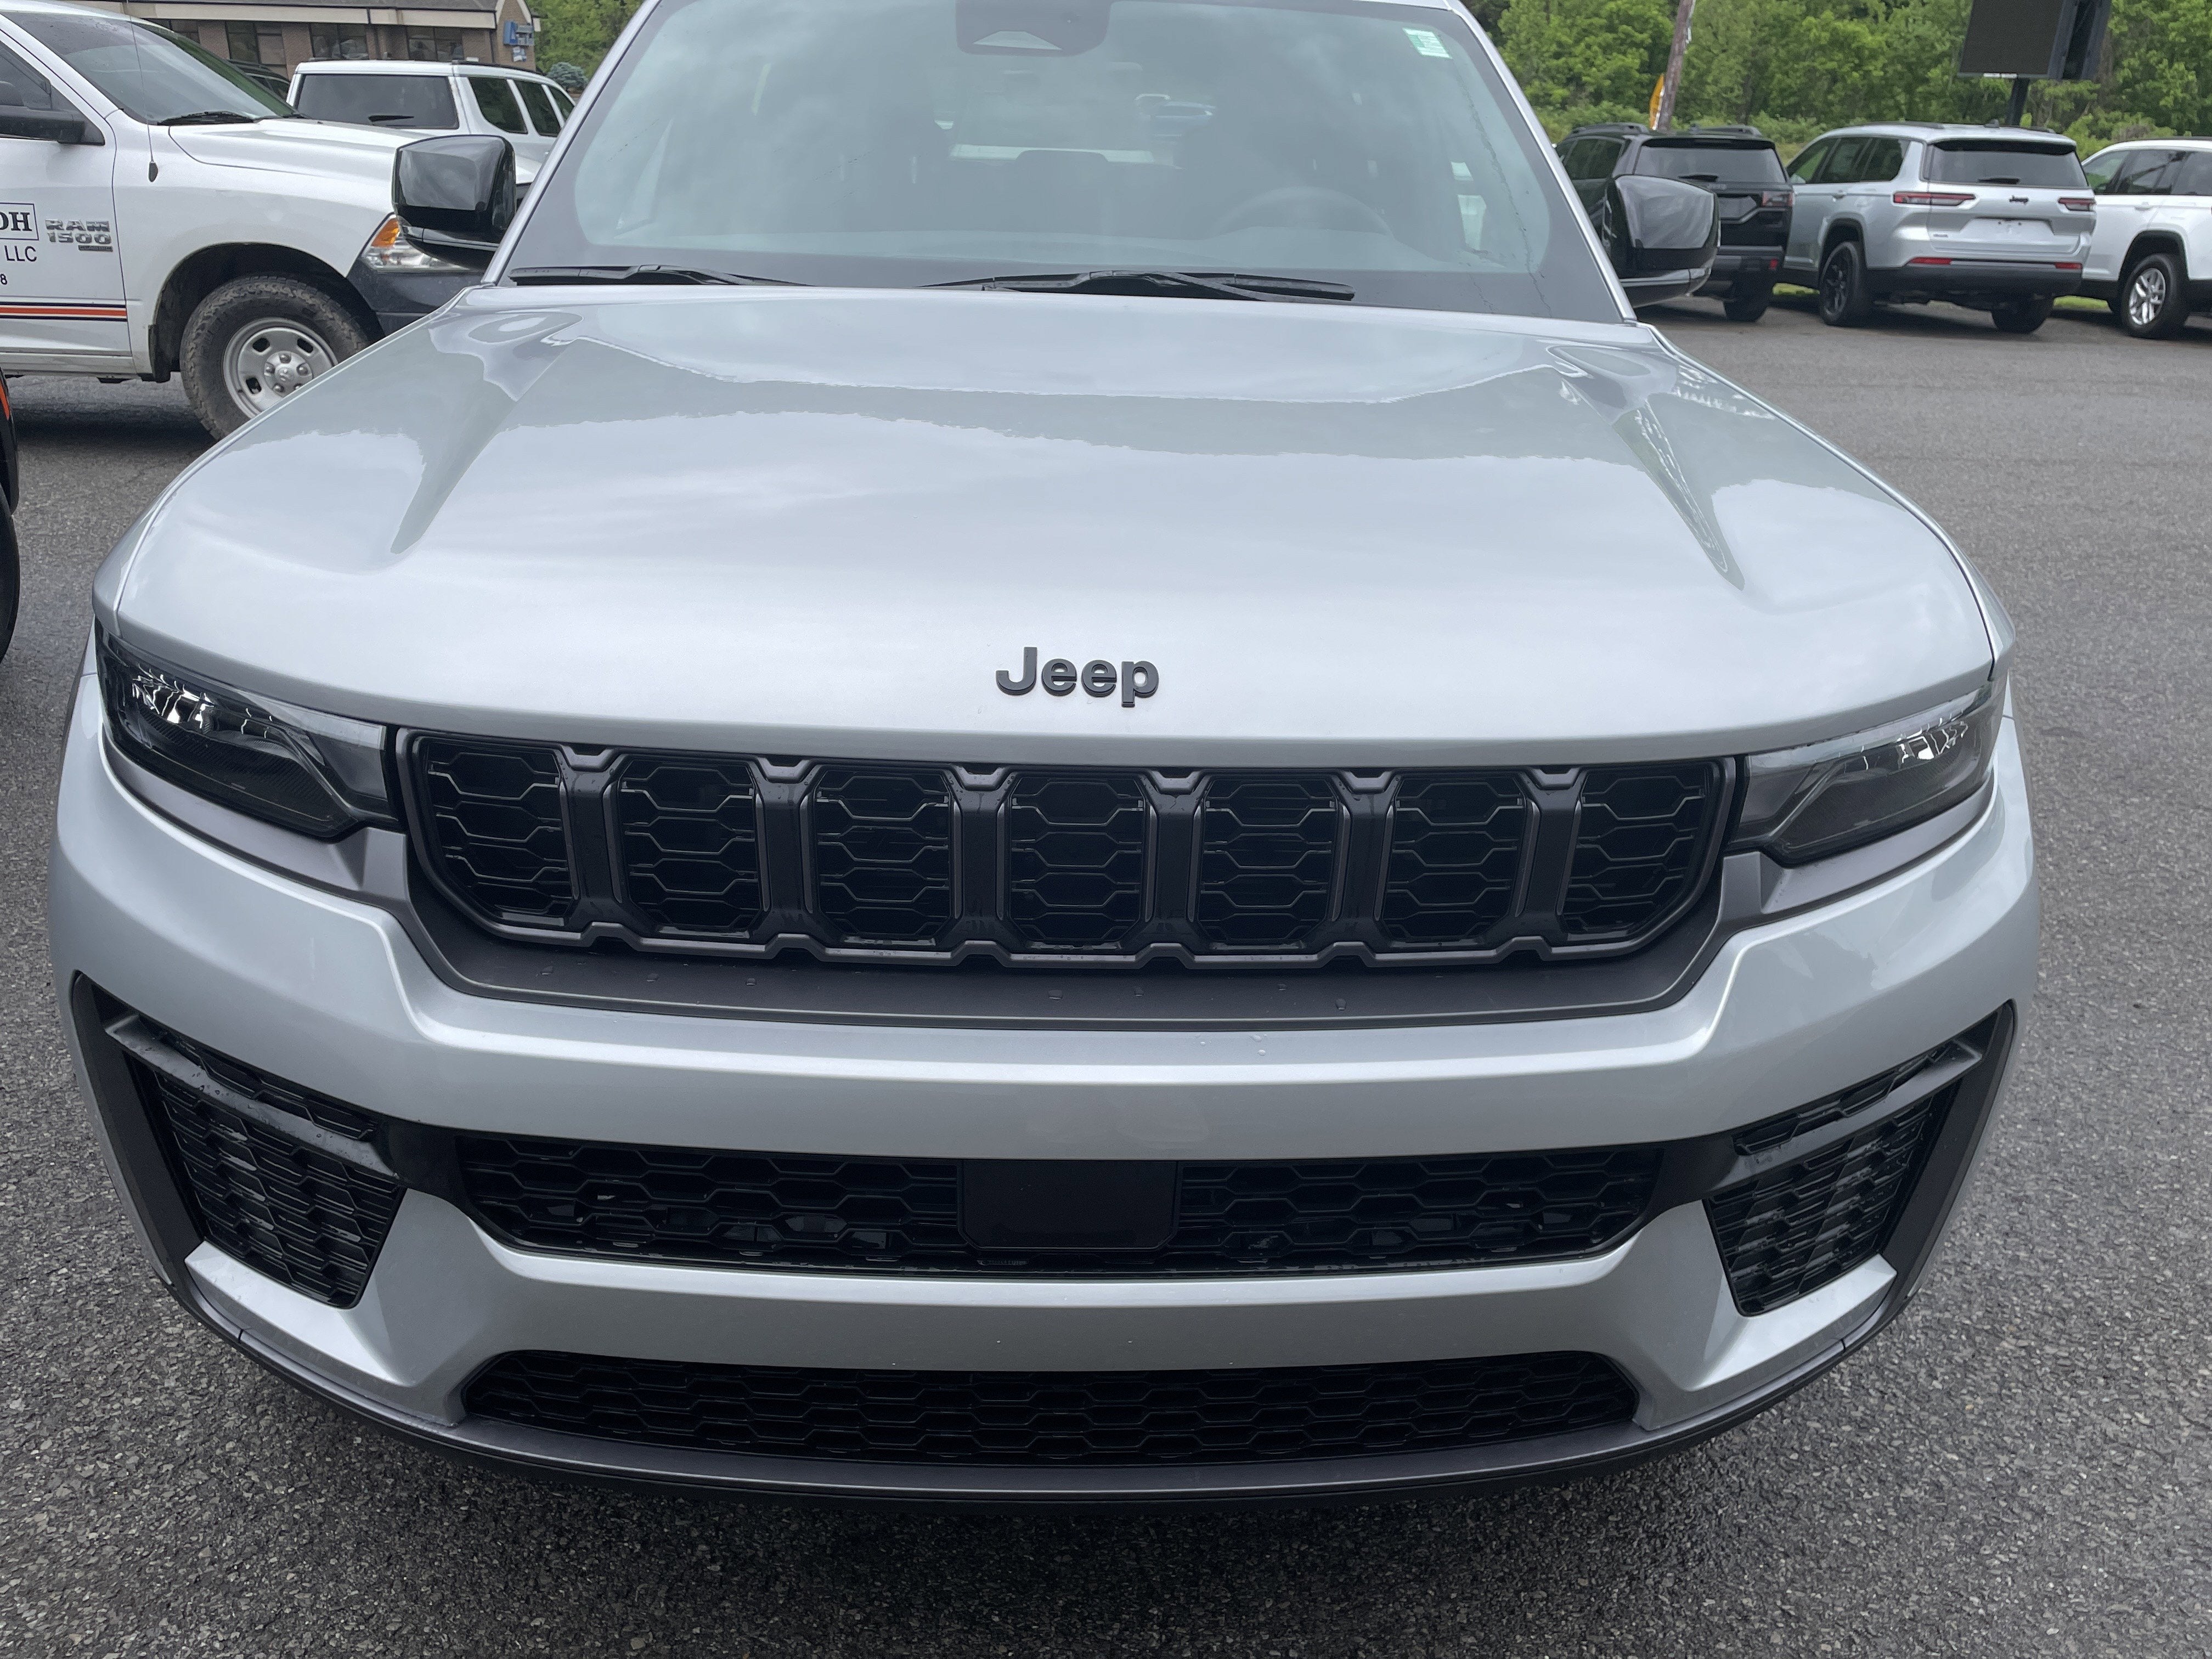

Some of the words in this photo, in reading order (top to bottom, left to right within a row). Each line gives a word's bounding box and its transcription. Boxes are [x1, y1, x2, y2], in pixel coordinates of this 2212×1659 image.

[45, 219, 110, 232] RAM
[47, 232, 111, 244] 1500
[4, 245, 37, 262] LLC
[1, 274, 7, 285] 8
[996, 647, 1159, 708] Jeep
